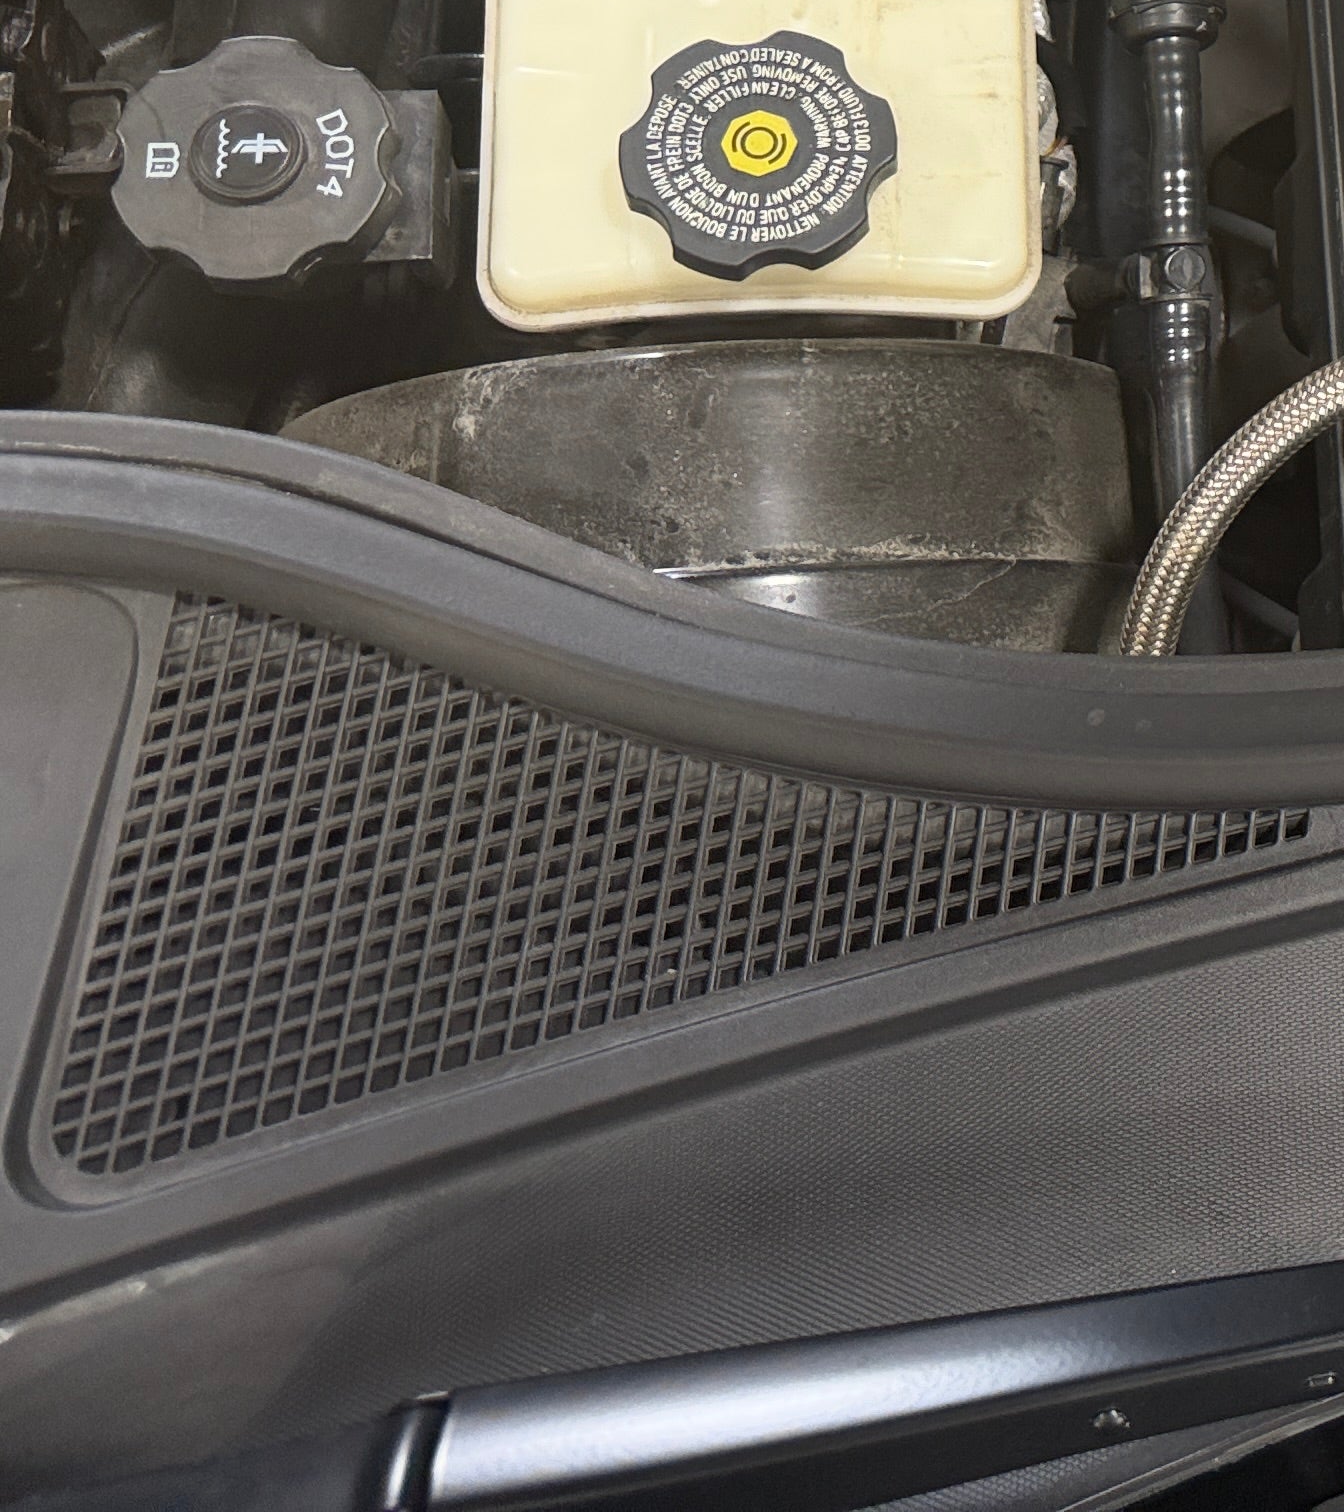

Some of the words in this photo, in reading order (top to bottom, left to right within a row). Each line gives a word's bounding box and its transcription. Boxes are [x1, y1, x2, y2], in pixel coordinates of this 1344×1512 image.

[751, 47, 801, 66] SEALED
[802, 57, 813, 69] A
[721, 66, 747, 85] USE
[690, 76, 720, 104] ONLY
[705, 83, 749, 112] FILLER
[752, 81, 795, 99] CLEAN
[647, 142, 662, 159] LA
[648, 163, 677, 198] AVANT
[674, 172, 693, 190] DE
[766, 153, 828, 206] PROVENANT
[736, 209, 755, 224] DU
[760, 206, 789, 224] QUE
[730, 225, 747, 242] LE
[752, 213, 819, 242] NETTOYER
